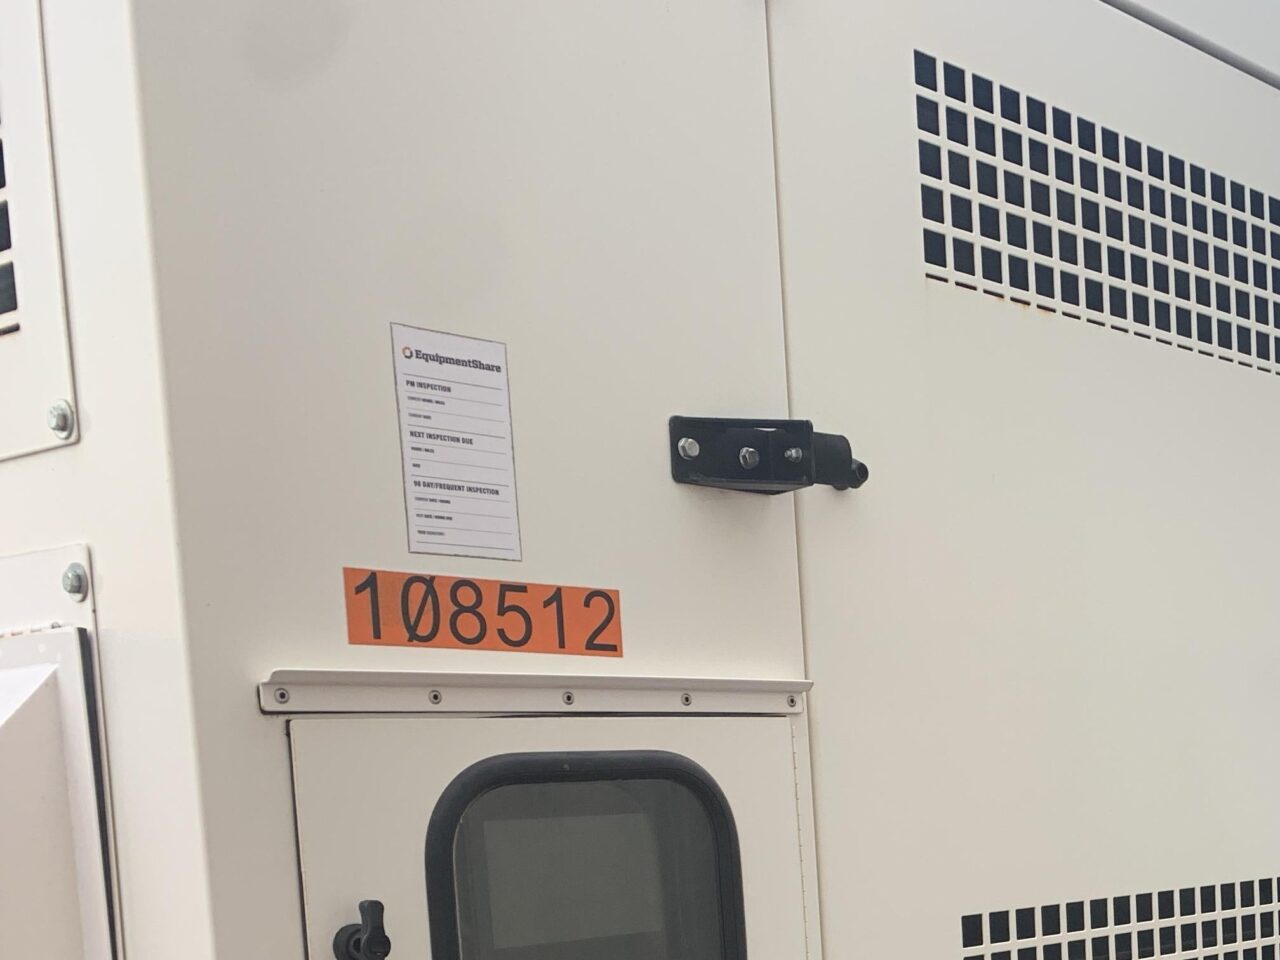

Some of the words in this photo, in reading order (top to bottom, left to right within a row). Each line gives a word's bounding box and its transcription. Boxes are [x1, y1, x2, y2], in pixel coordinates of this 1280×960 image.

[415, 349, 502, 373] EquipmentShare
[406, 380, 415, 388] PM
[416, 381, 451, 393] INSPECTION
[409, 430, 425, 439] NEXT
[426, 433, 460, 443] INSPECTION
[461, 437, 473, 445] DUE
[466, 486, 499, 495] INSPECTION
